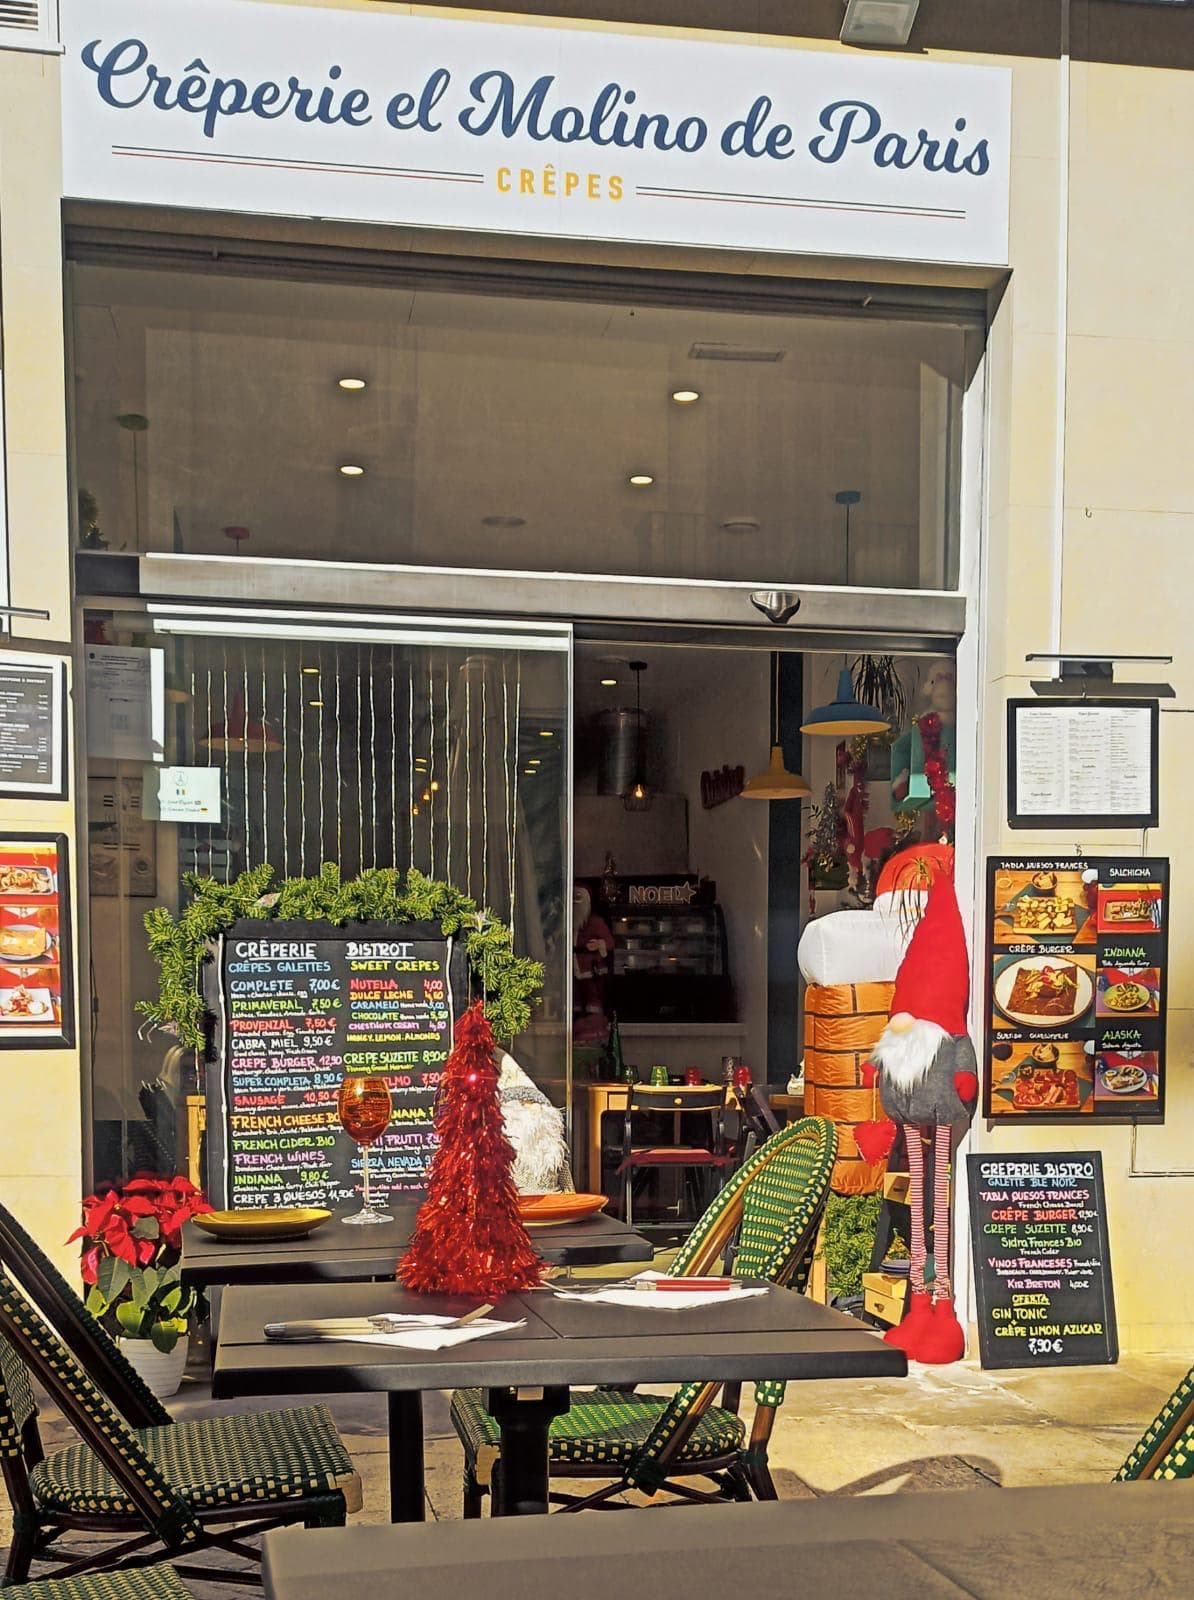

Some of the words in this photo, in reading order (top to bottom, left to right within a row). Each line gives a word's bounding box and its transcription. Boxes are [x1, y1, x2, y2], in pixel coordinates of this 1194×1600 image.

[81, 38, 373, 138] Crêperie
[386, 68, 451, 132] el
[457, 70, 707, 154] Molino
[720, 95, 795, 159] de
[808, 100, 990, 176] Paris
[496, 162, 625, 201] CRÊPES
[1109, 867, 1151, 877] SALCHICHA
[235, 940, 317, 958] CRÊPERIE
[346, 942, 413, 956] BISTROT
[1008, 943, 1036, 953] CRÊPE
[1039, 945, 1074, 954] BURGER
[1103, 947, 1146, 958] INDIANA
[228, 960, 271, 973] CRÊPES
[277, 961, 331, 972] GALETTES
[350, 960, 391, 971] SWEET
[395, 960, 440, 971] CREPES
[231, 980, 293, 991] COMPLETE
[350, 978, 398, 990] NUTELLA
[350, 991, 380, 1000] DULCE
[384, 990, 414, 999] LECHE
[232, 999, 303, 1010] PRIMAVERAL
[351, 1001, 399, 1009] CARAMELO
[351, 1011, 400, 1020] CHOCOLATE
[230, 1020, 294, 1031] PROVENZAL
[1102, 1030, 1142, 1041] ALASKA
[231, 1039, 267, 1049] CABRA
[271, 1039, 298, 1048] MIEL
[231, 1058, 267, 1068] CREPE
[271, 1057, 316, 1068] BURGER
[343, 1053, 379, 1064] CREPE
[380, 1051, 419, 1063] SUZETTE
[233, 1078, 263, 1087] SUPER
[265, 1077, 312, 1086] COMPLETA
[233, 1095, 286, 1105] SAUSAGE
[230, 1115, 281, 1129] FRENCH
[283, 1115, 325, 1125] CHEESE
[233, 1139, 279, 1151] FRENCH
[316, 1136, 335, 1147] BIO
[233, 1153, 283, 1165] FRENCH
[287, 1151, 325, 1162] WINES
[388, 1157, 423, 1167] NEVADA
[981, 1163, 1041, 1175] CREPERIE
[1044, 1162, 1094, 1176] BISTRO
[233, 1173, 283, 1185] INDIANA
[988, 1178, 1025, 1187] GALETTE
[1030, 1177, 1048, 1187] BLE
[1051, 1178, 1077, 1187] NOIR
[233, 1194, 269, 1203] CREPE
[273, 1193, 280, 1202] 3
[283, 1189, 326, 1204] QUESOS
[979, 1191, 1009, 1202] TABLA
[1011, 1191, 1045, 1203] QUESOS
[1046, 1189, 1090, 1200] FRANCES
[991, 1207, 1029, 1221] CRÊPE
[1033, 1209, 1078, 1221] BURGER
[983, 1224, 1017, 1234] CREPE
[1024, 1223, 1067, 1234] SUZETTE
[1028, 1237, 1065, 1247] Frances
[988, 1258, 1017, 1269] VINOS
[1018, 1257, 1073, 1269] FRANCESES
[992, 1308, 1012, 1319] GIN
[1014, 1308, 1047, 1320] TONIC
[995, 1324, 1026, 1337] CRÊPE
[1030, 1325, 1060, 1335] LIMON
[1063, 1323, 1103, 1335] AZUCAR
